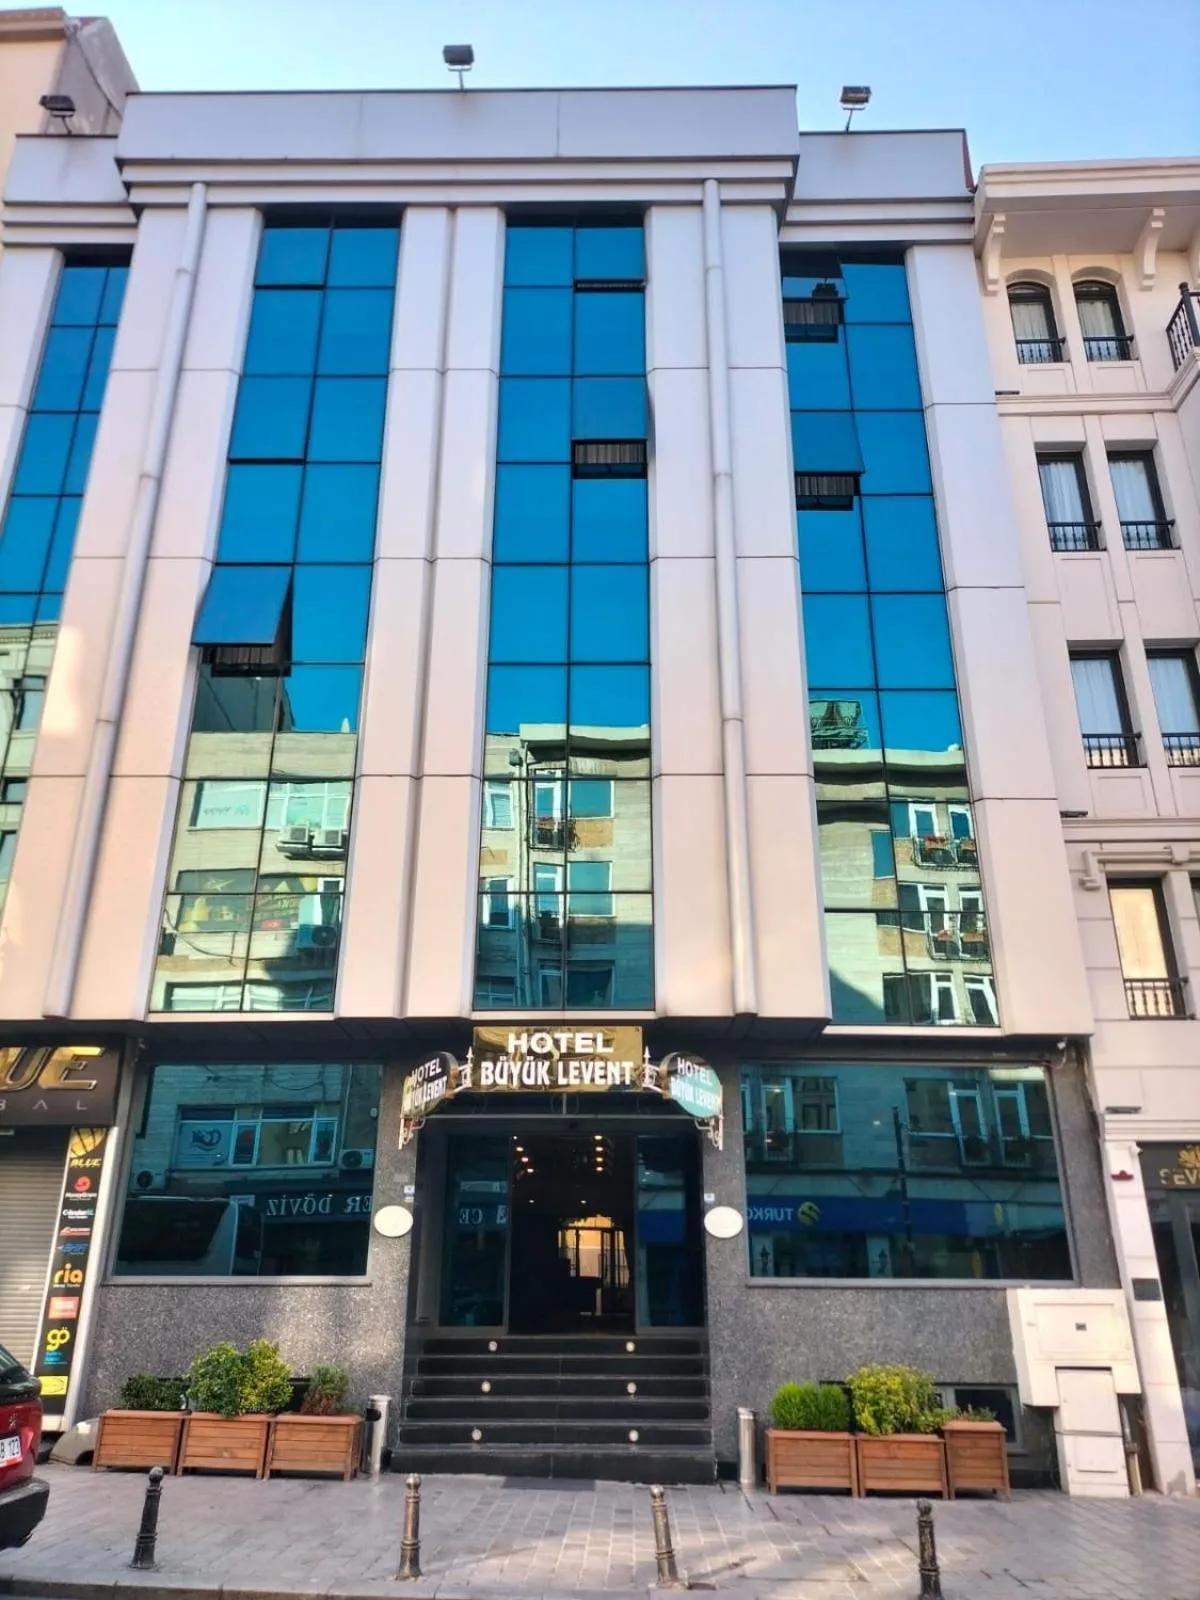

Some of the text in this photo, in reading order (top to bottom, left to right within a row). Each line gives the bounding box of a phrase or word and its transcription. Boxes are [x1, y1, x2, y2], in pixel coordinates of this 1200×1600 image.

[508, 1032, 615, 1054] HOTEL
[411, 1058, 442, 1083] HOTEL
[480, 1055, 634, 1086] BÜYÜK LEVENT
[677, 1056, 713, 1087] HOTEL
[53, 1263, 83, 1284] ria
[46, 1326, 70, 1351] gö
